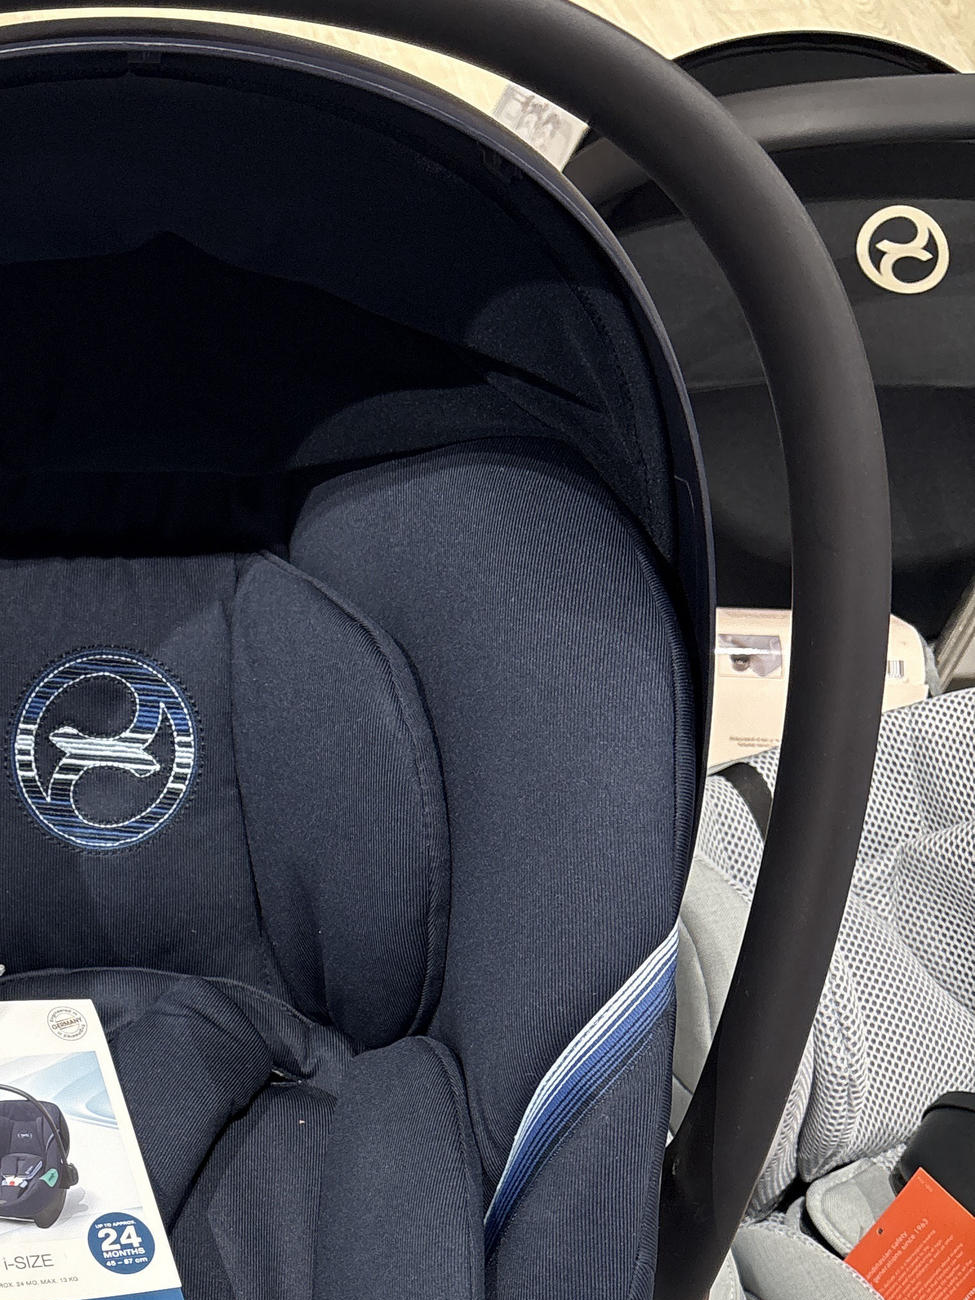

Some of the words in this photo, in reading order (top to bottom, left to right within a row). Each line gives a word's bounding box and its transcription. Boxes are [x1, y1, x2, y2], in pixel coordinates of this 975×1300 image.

[97, 1225, 142, 1252] 24
[3, 1253, 54, 1271] i-SIZE
[103, 1247, 146, 1259] MONTHS
